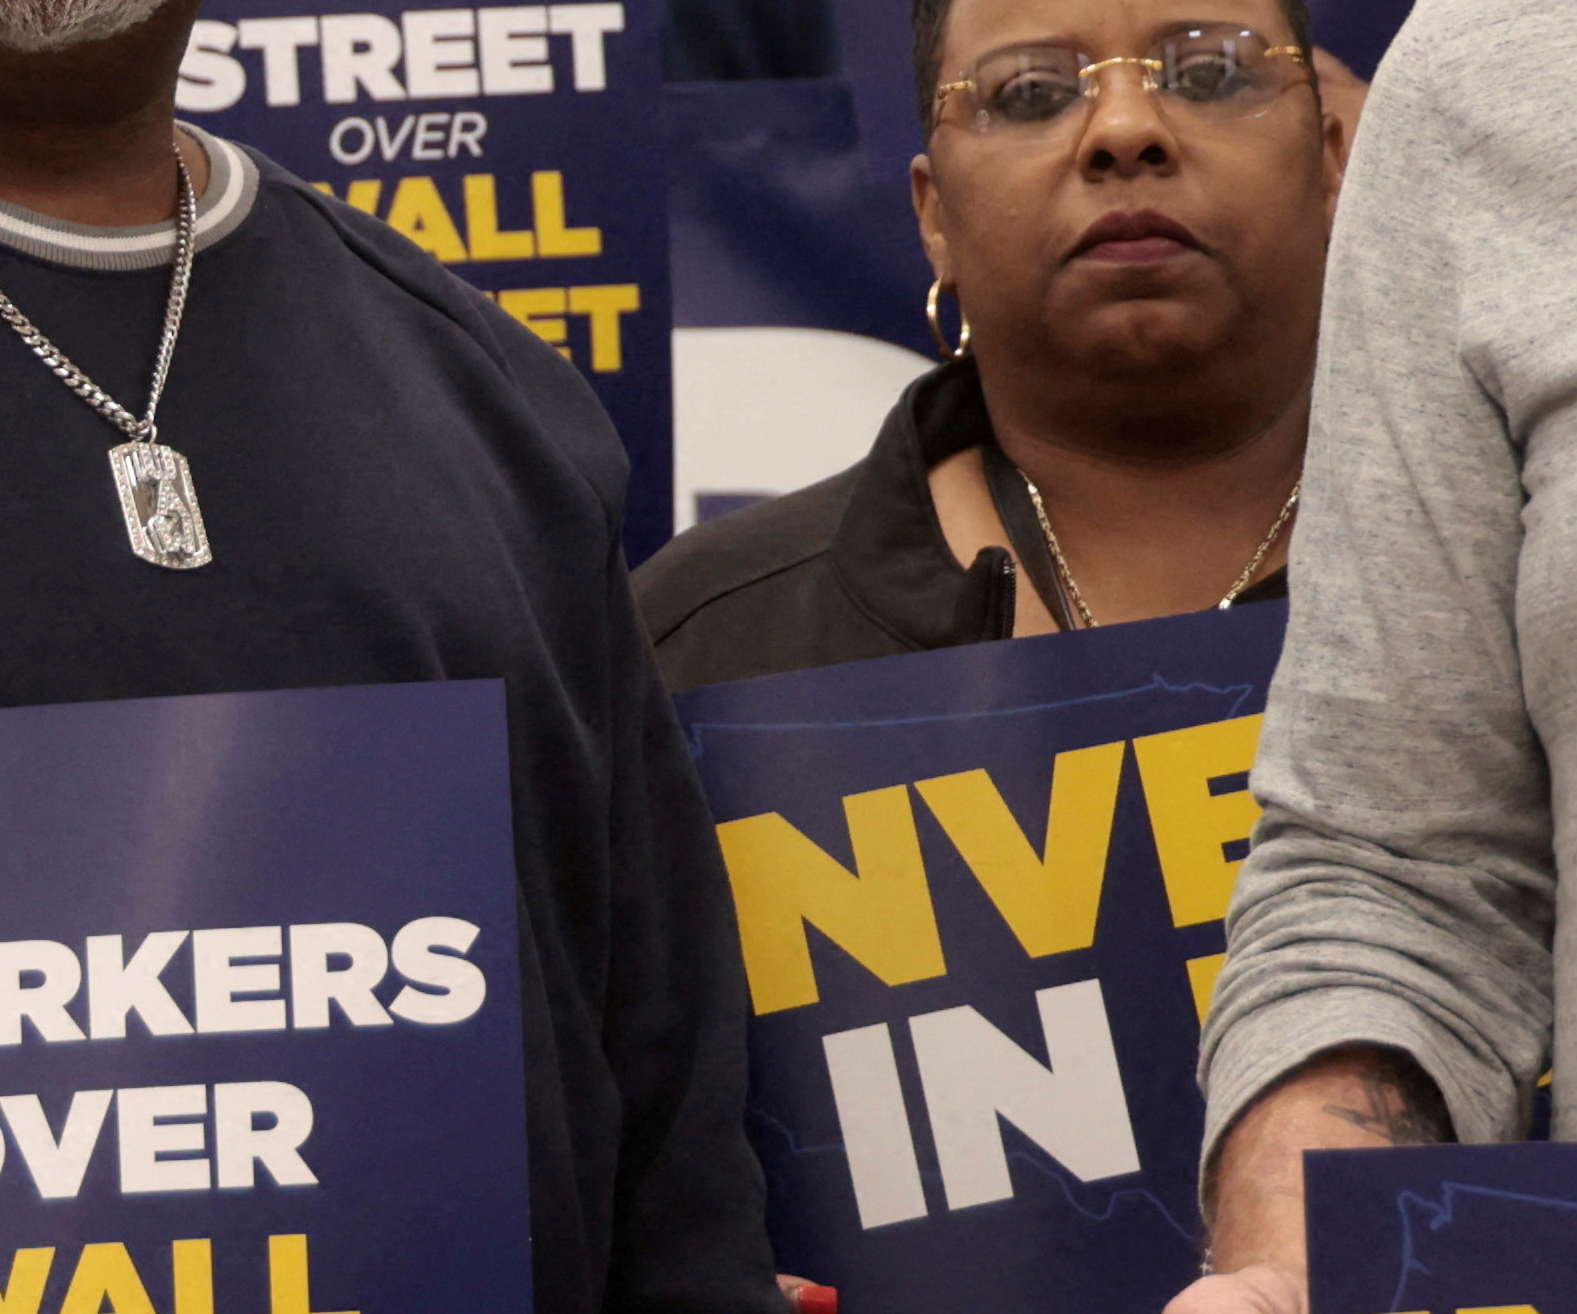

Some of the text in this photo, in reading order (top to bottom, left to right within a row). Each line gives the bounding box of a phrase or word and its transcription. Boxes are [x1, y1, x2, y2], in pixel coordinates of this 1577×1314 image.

[174, 2, 626, 112] STREET
[328, 111, 488, 165] OVER
[821, 978, 1141, 1231] IN
